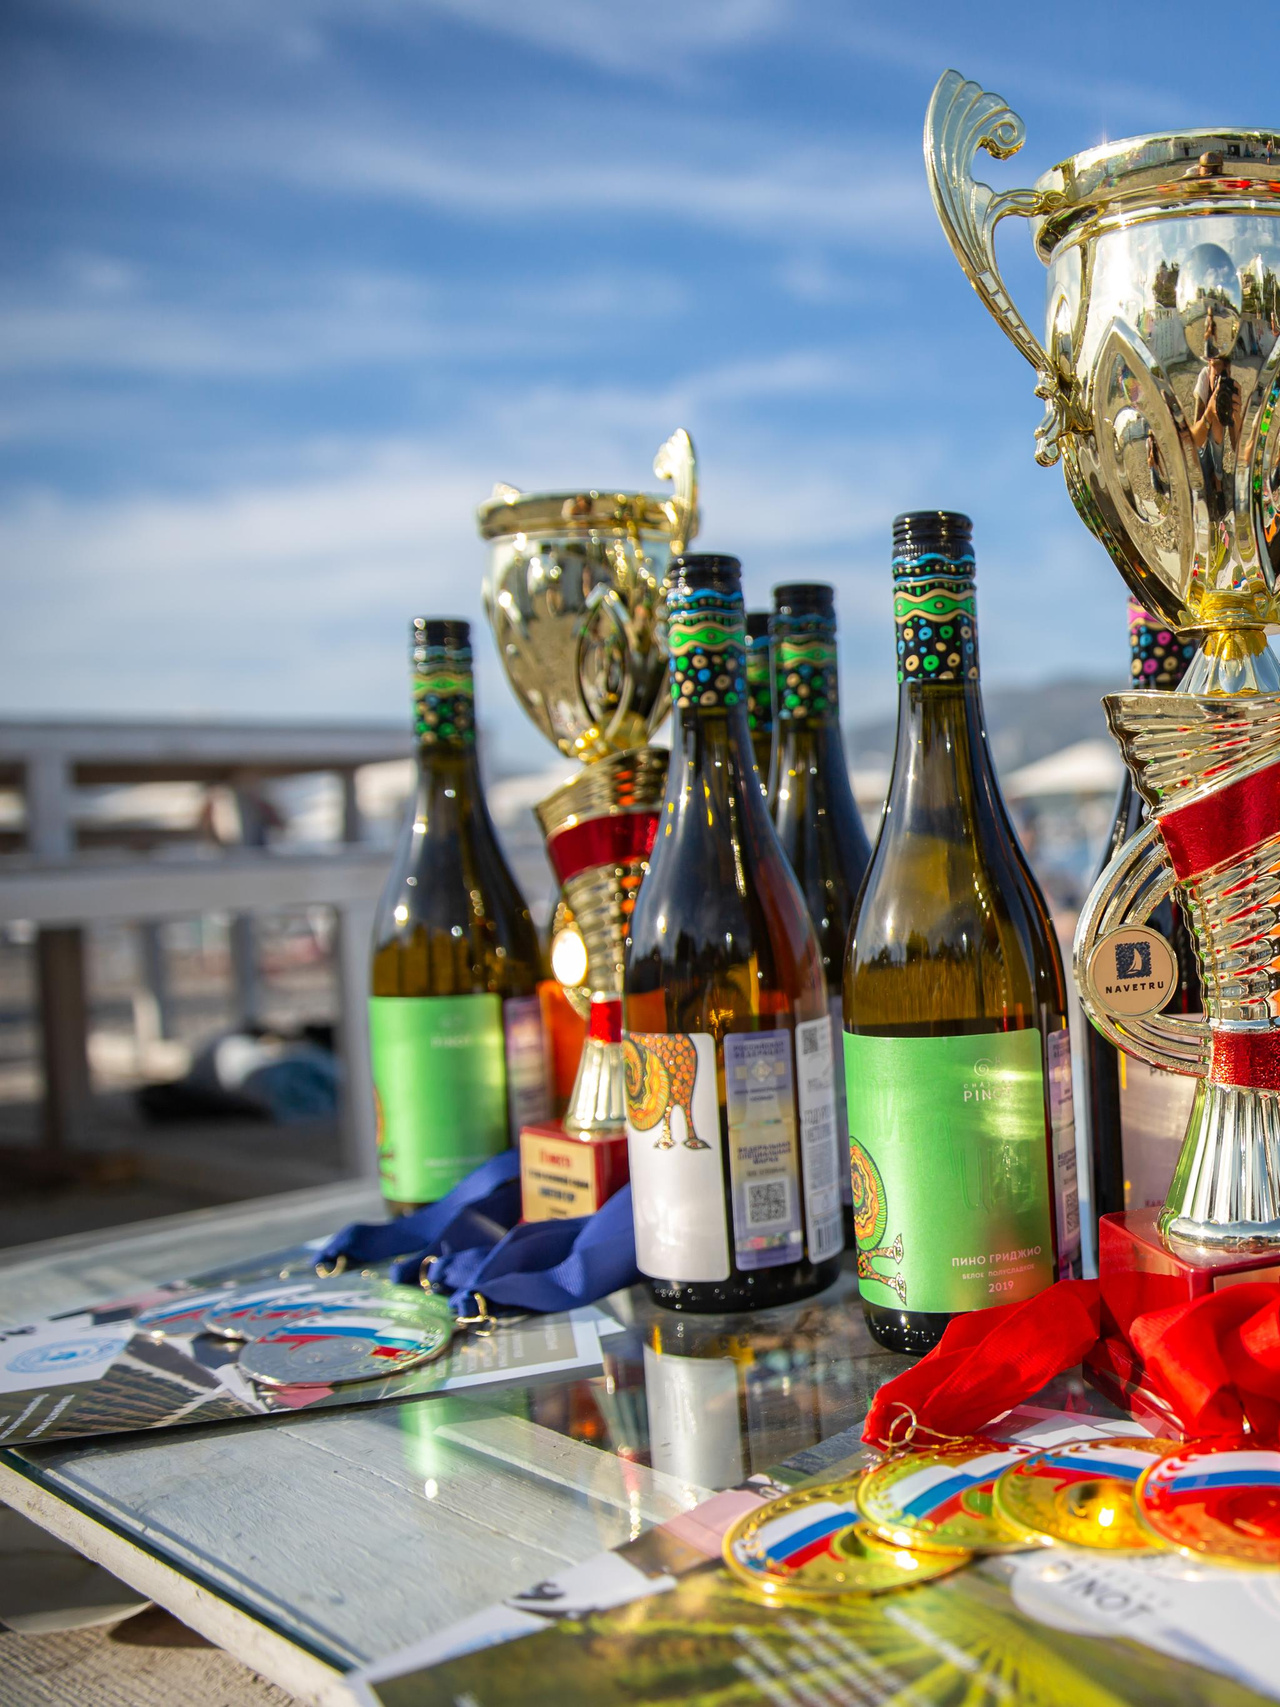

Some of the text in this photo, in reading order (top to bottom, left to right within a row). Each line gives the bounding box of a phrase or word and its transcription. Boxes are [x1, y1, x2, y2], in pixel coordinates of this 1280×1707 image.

[1105, 981, 1165, 994] NAVETRU
[952, 1245, 1041, 1267] ПИНО ГРИДЖИО
[962, 1264, 1035, 1280] БЕЛОЕ ПОЛУСЛАДКОЕ
[988, 1280, 1014, 1293] 2019
